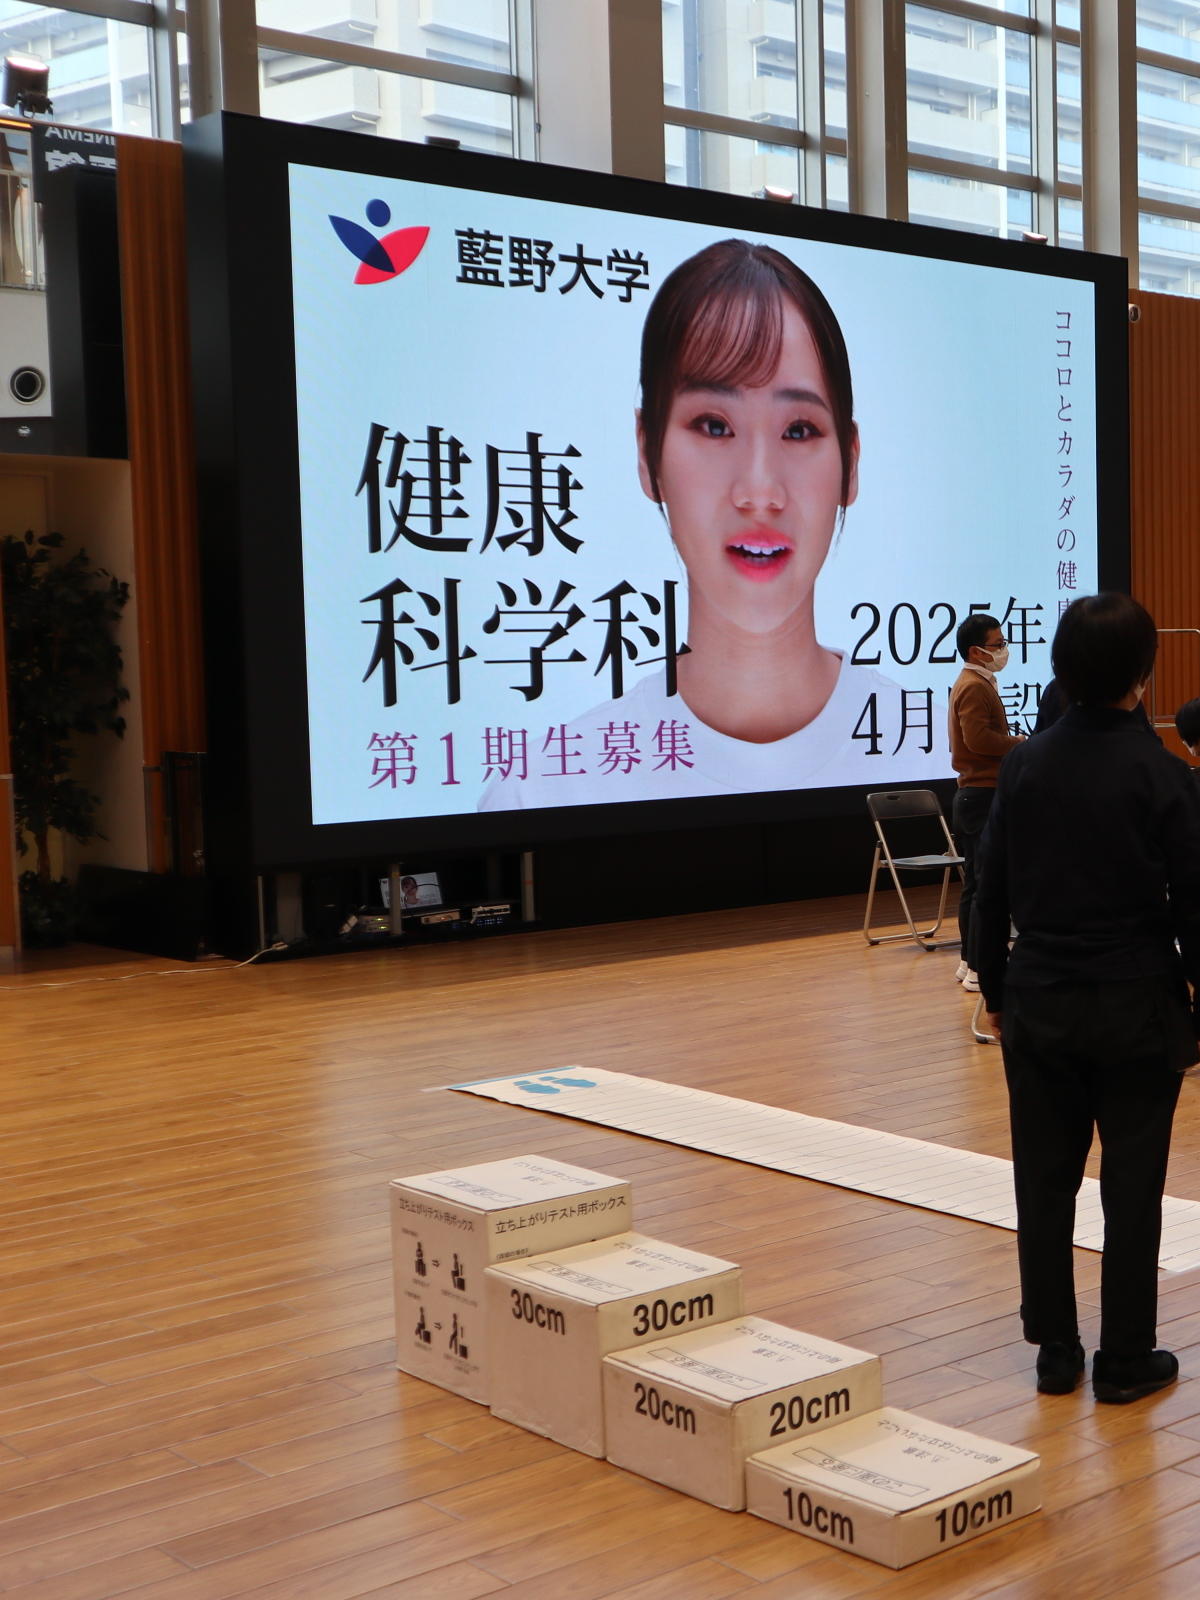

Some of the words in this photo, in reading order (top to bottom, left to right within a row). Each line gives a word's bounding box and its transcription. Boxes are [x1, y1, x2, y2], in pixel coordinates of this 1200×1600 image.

[454, 227, 650, 303] 藍野大学
[355, 422, 585, 556] 健康
[359, 577, 692, 708] 科学科
[850, 596, 1046, 666] 202年
[851, 682, 1042, 756] 4月設
[366, 719, 696, 789] 第1期生募集
[400, 1198, 475, 1232] 立ち上がりテスト用ボックス
[496, 1196, 627, 1234] 立ち上がりテスト用ボックス
[510, 1289, 566, 1335] 30cm
[633, 1293, 714, 1336] 30cm
[634, 1382, 696, 1434] 20cm
[769, 1387, 850, 1437] 20cm
[783, 1488, 854, 1544] 10cm
[935, 1490, 1013, 1542] 10cm
